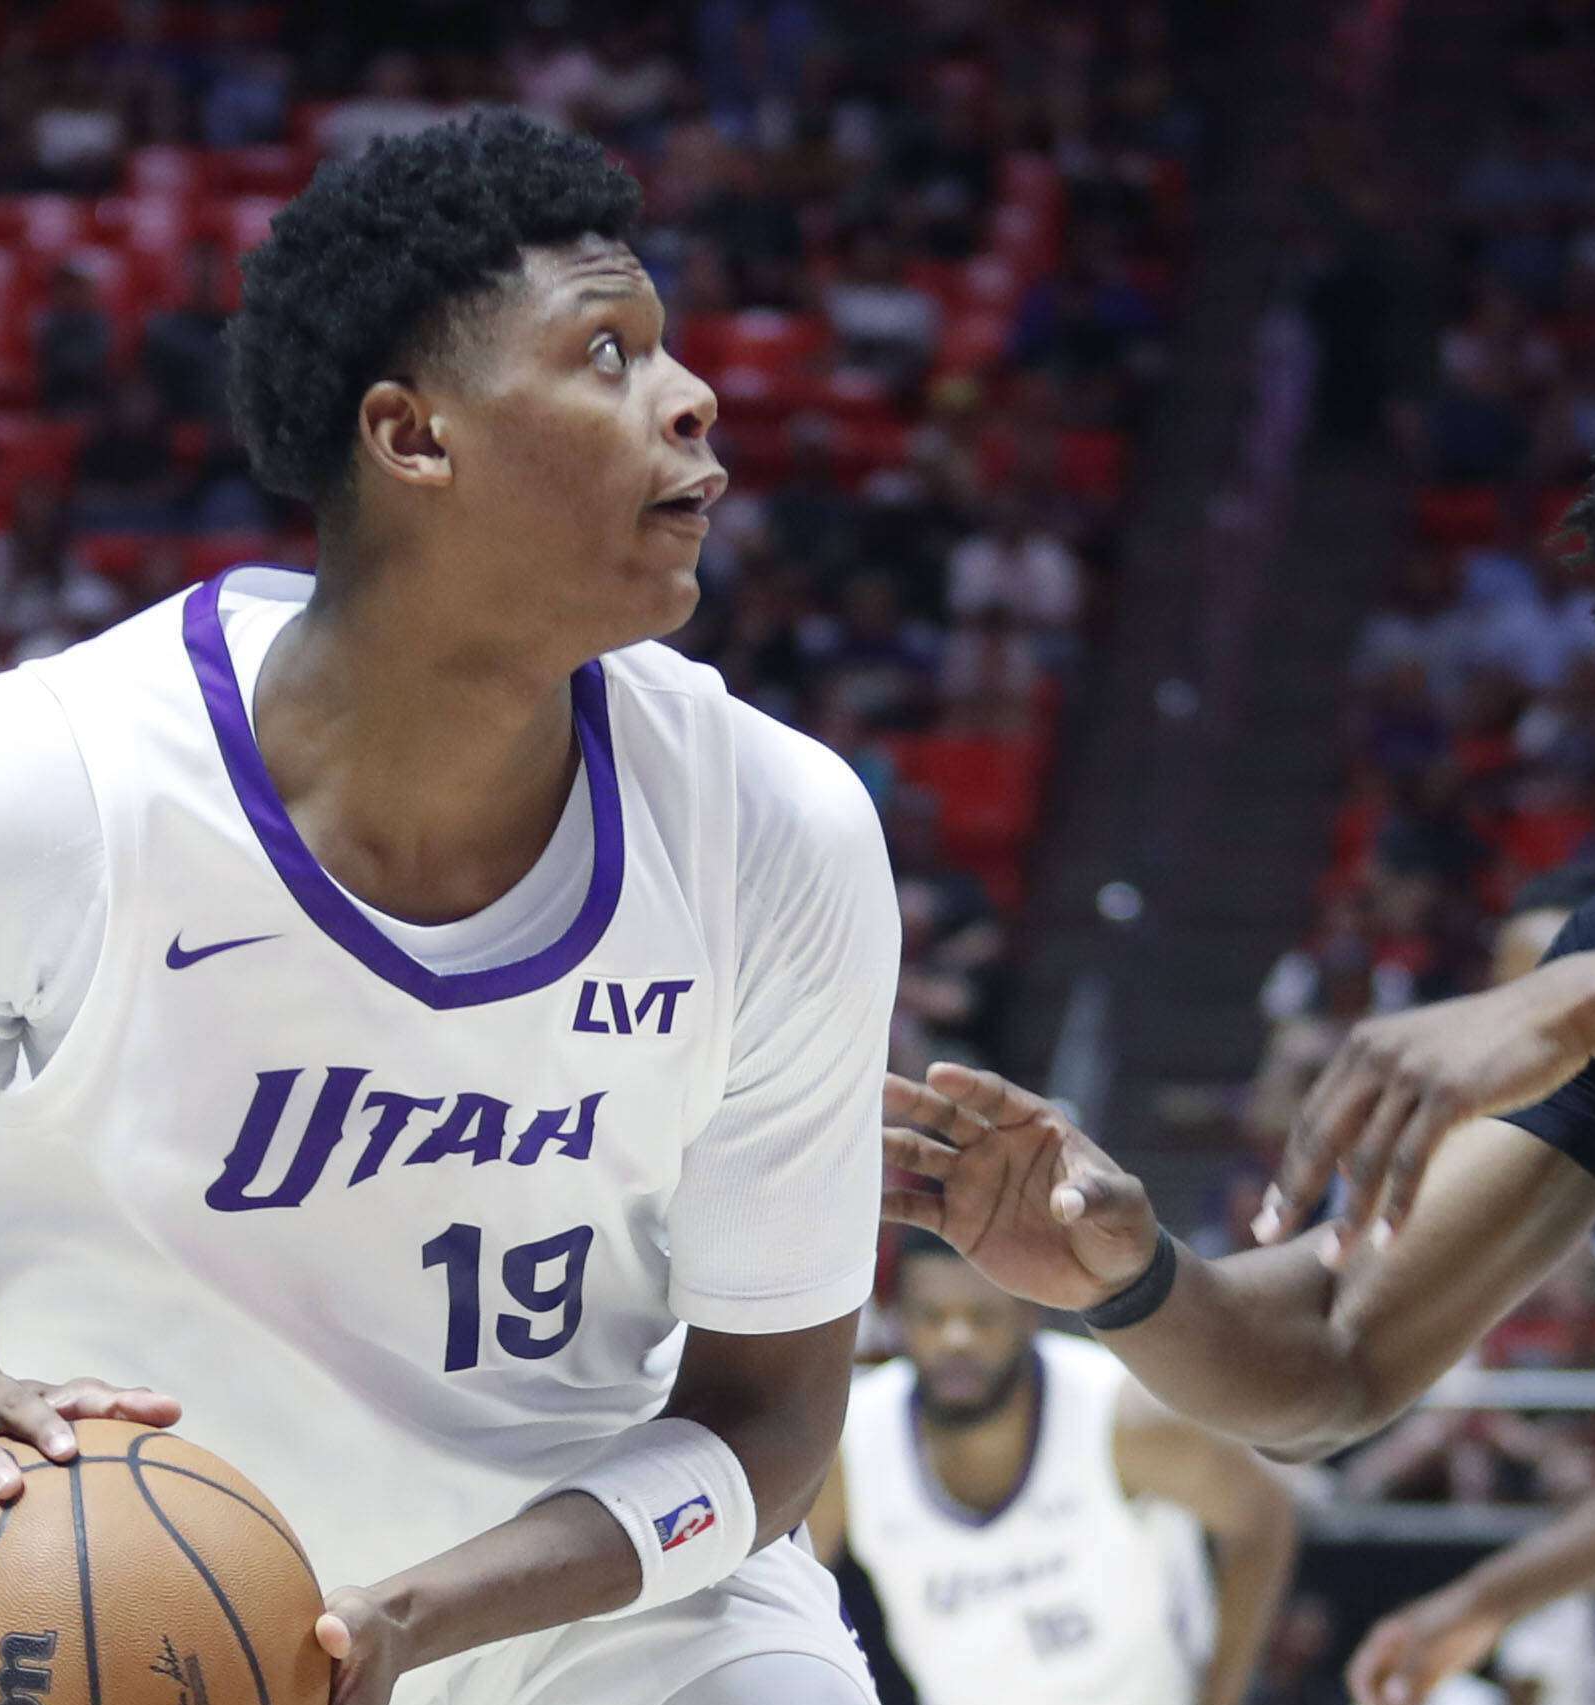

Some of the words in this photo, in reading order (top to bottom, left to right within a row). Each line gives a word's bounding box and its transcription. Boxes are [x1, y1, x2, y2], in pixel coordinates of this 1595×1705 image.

[570, 978, 695, 1035] LVT
[204, 1066, 609, 1212] UTAH
[421, 1222, 594, 1373] 19
